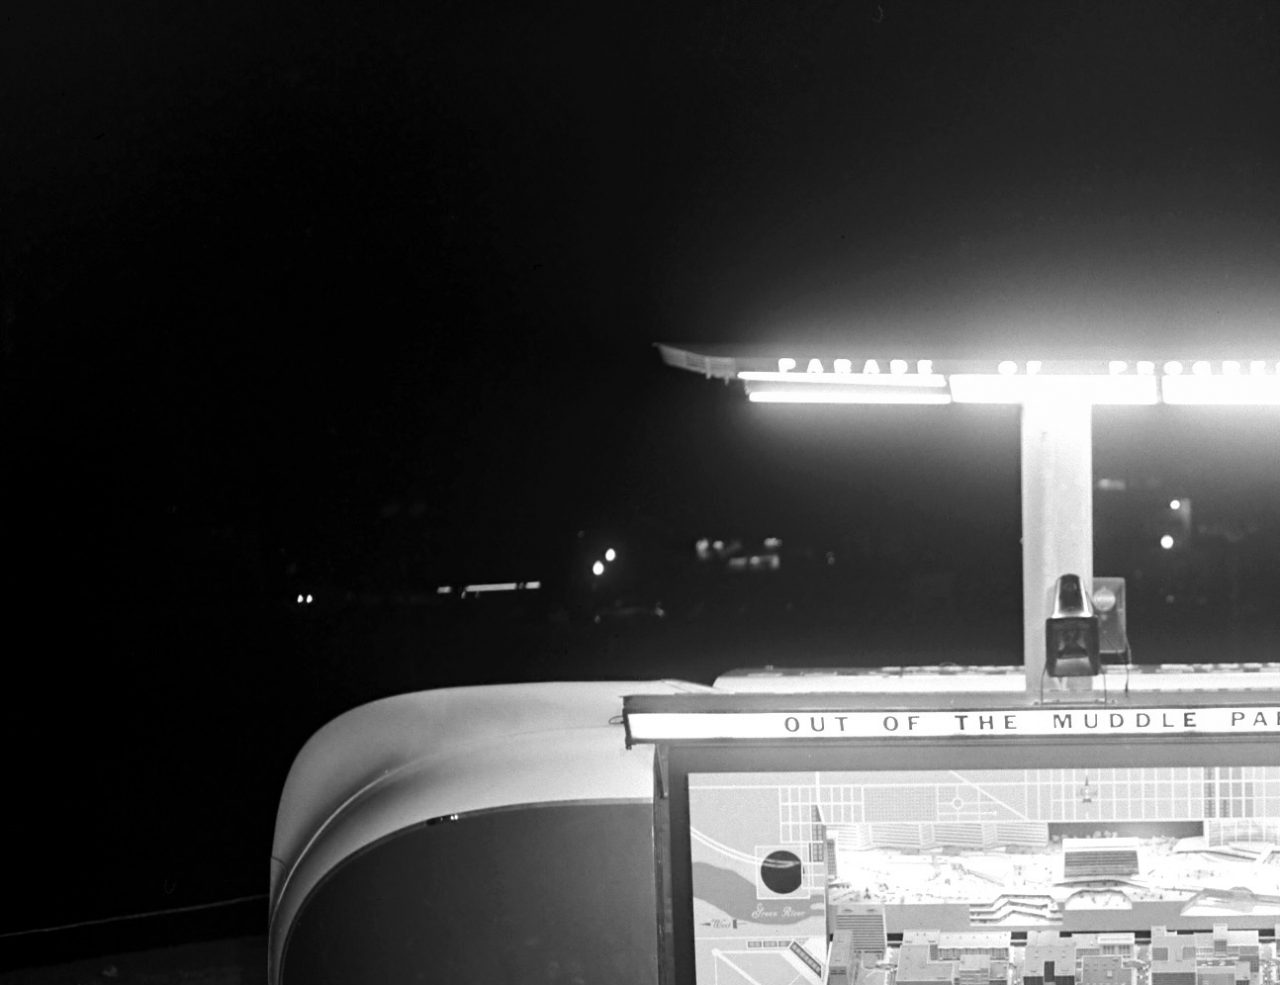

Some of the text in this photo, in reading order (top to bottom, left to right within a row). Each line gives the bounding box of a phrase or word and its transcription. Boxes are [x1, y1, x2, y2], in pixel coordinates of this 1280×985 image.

[778, 357, 934, 376] PARADE
[783, 716, 849, 733] OUT
[882, 715, 921, 732] OF
[954, 714, 1018, 731] THE
[1052, 711, 1198, 729] MUDDLE
[751, 902, 806, 919] Green River
